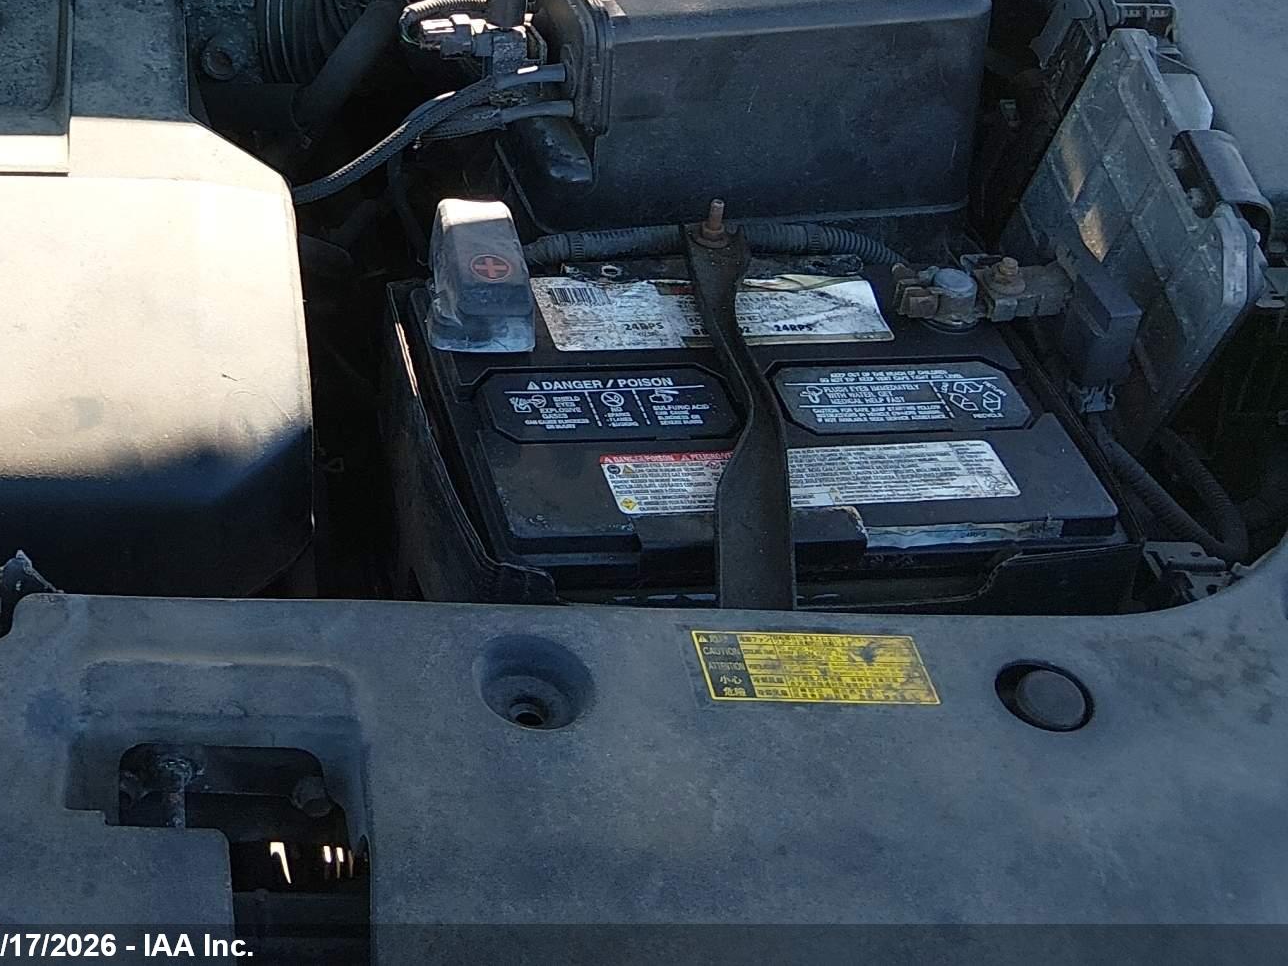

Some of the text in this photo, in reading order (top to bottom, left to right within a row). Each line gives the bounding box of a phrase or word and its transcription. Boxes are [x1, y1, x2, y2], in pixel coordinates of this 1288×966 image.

[541, 377, 674, 390] DANGER / POISON
[703, 646, 741, 655] CAUTION
[709, 662, 746, 671] ATTENTION
[720, 675, 742, 685] 小心
